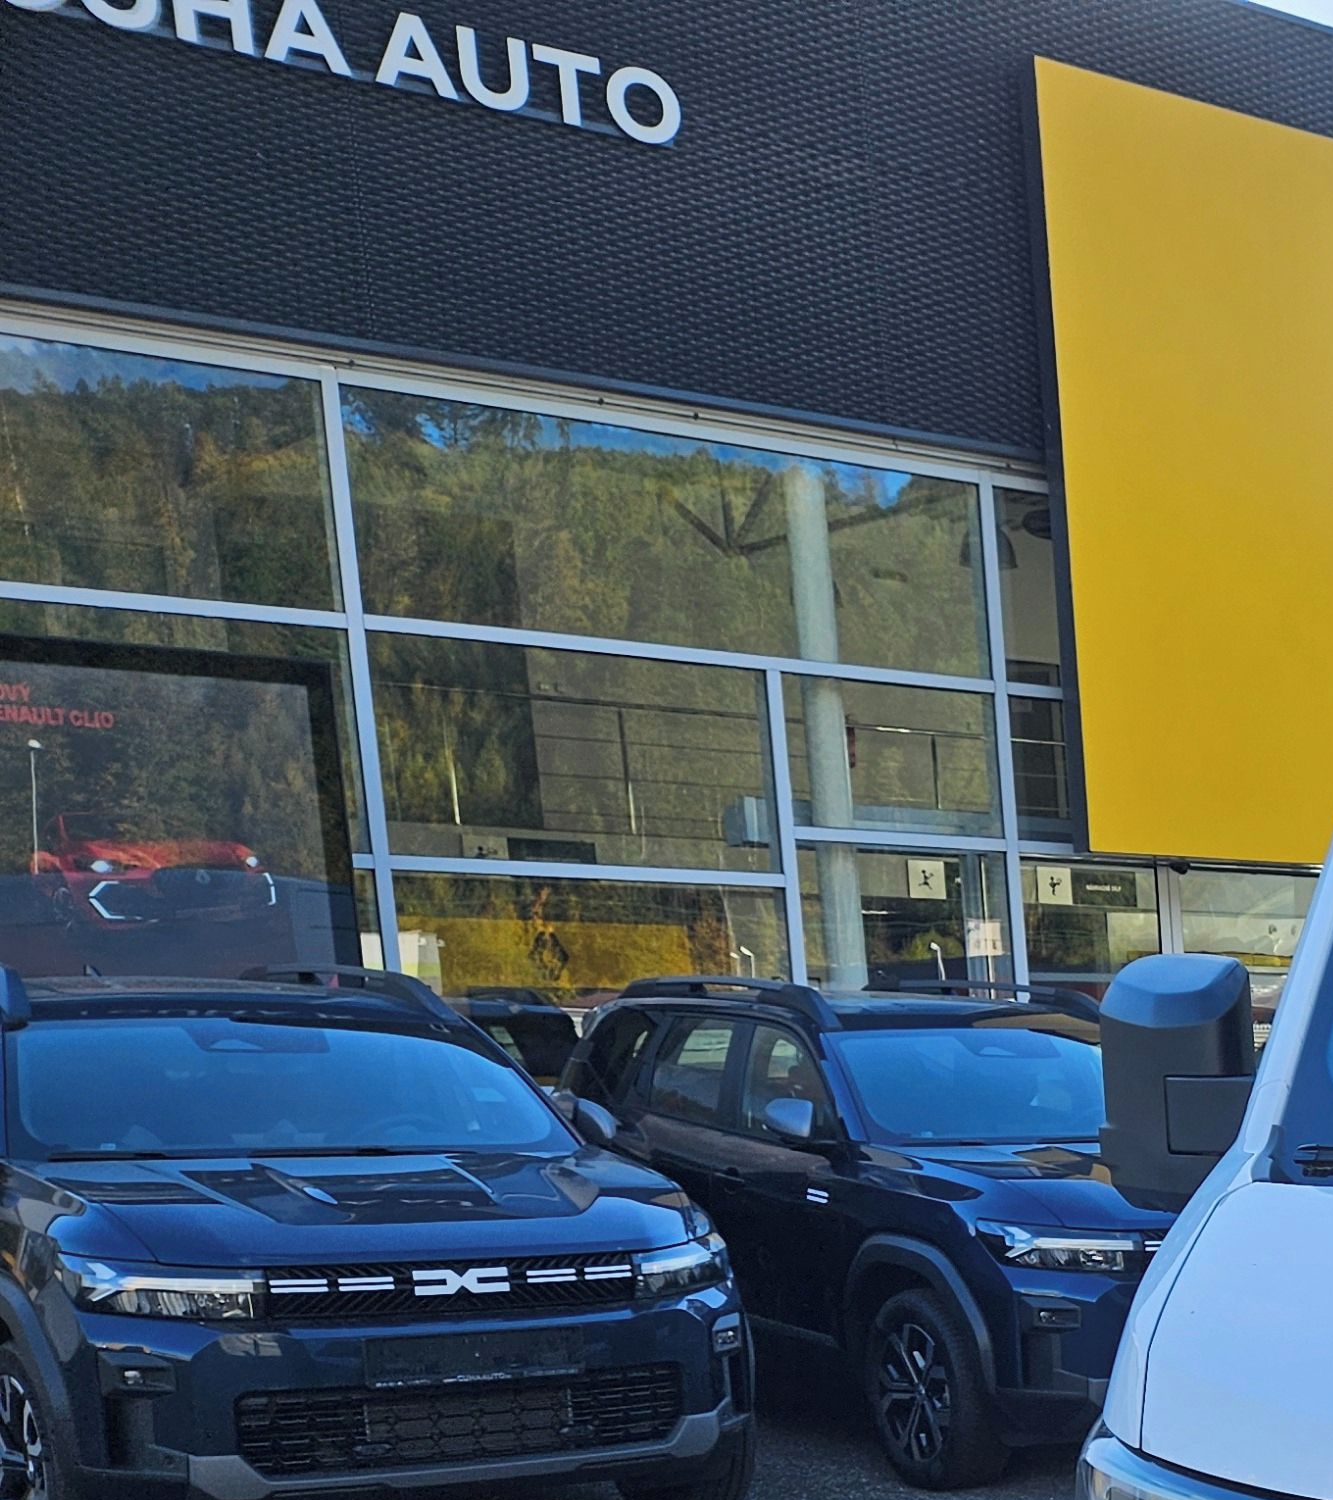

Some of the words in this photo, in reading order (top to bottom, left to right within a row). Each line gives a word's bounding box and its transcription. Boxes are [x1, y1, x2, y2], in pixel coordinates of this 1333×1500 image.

[4, 0, 352, 78] HA
[375, 12, 682, 145] AUTO
[69, 709, 114, 729] CLIO
